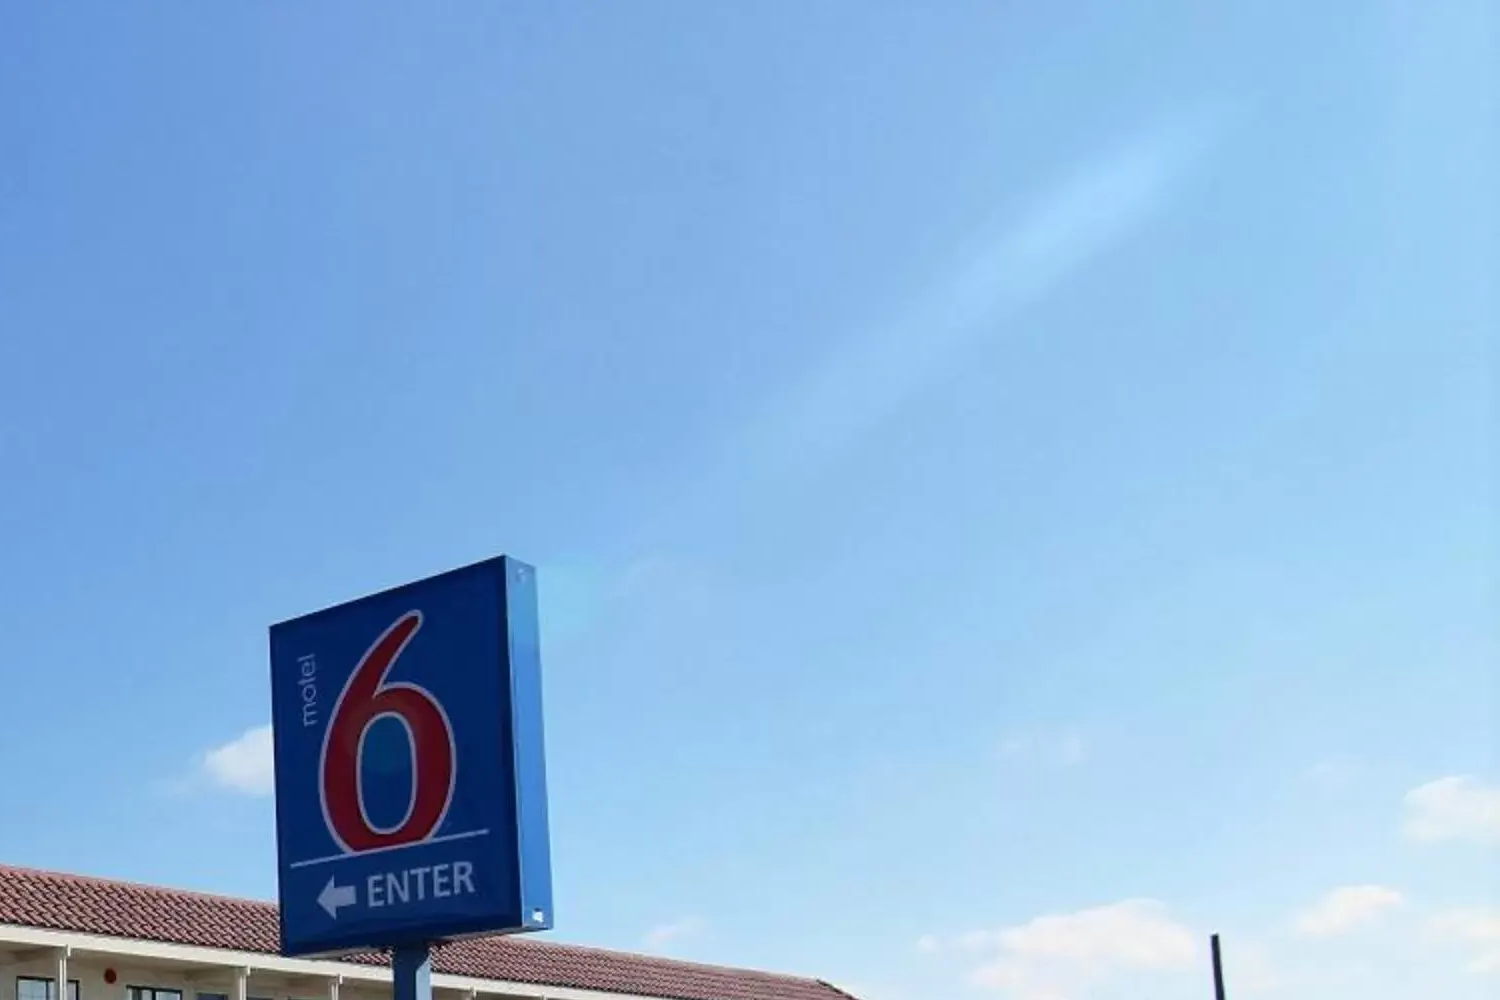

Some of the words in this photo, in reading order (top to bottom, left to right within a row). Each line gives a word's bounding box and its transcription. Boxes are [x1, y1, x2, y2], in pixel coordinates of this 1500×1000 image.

[297, 652, 318, 727] motel
[318, 609, 457, 856] 6
[366, 861, 476, 908] ENTER
